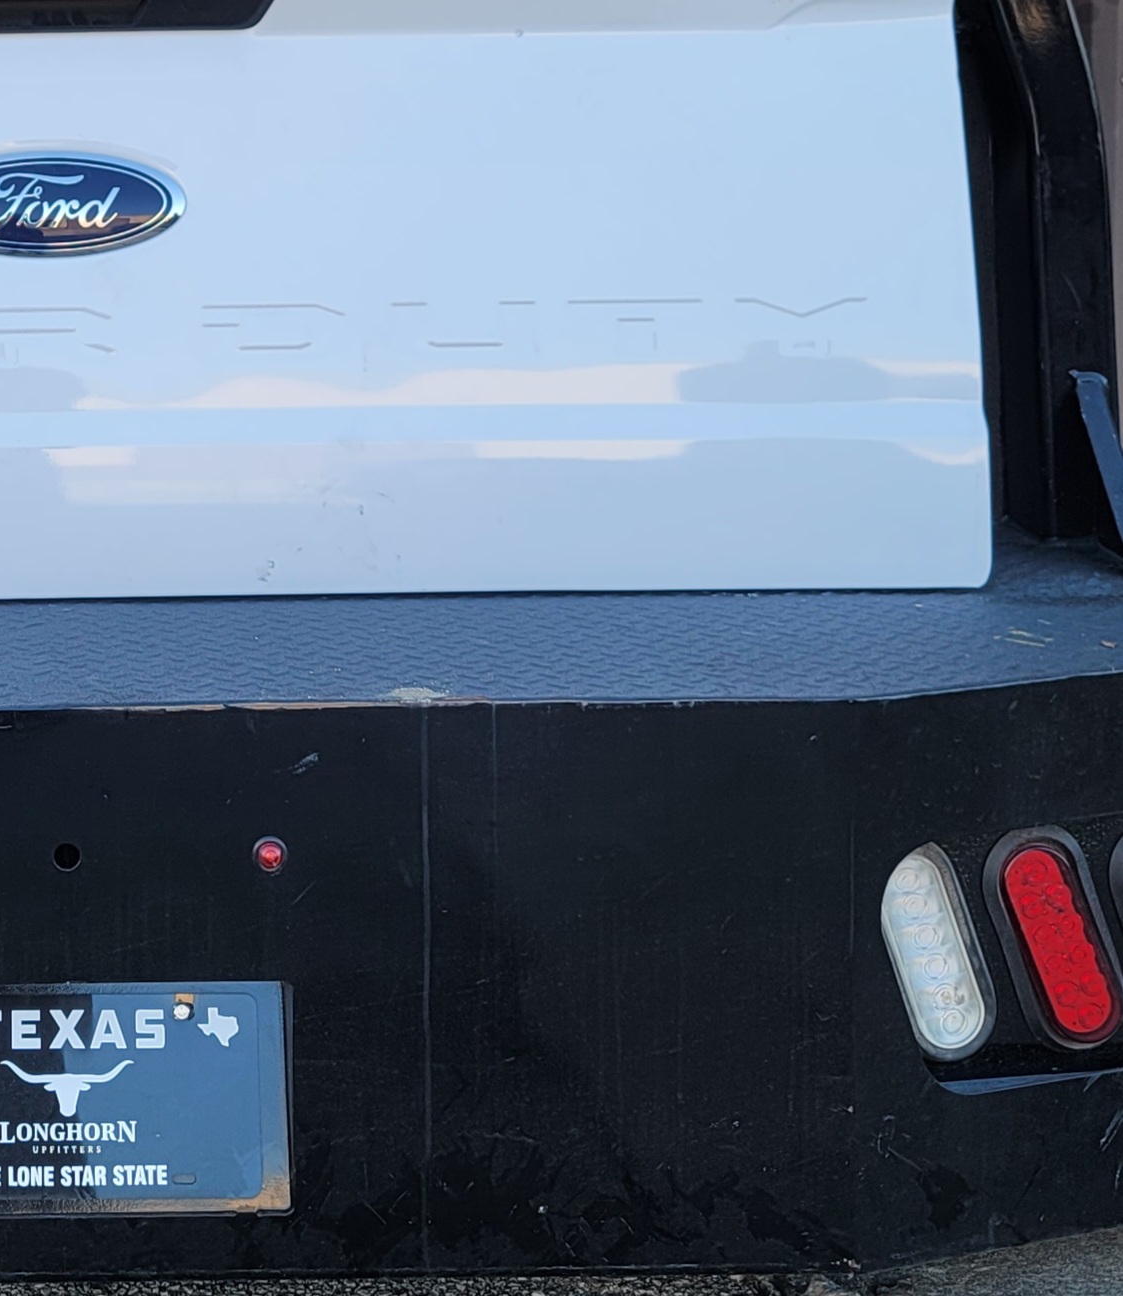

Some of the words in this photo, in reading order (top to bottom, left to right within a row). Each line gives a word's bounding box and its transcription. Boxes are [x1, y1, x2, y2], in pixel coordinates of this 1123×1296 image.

[201, 296, 869, 362] DUTY
[0, 1120, 138, 1144] LONGHORN
[32, 1145, 103, 1154] UPFITTERS
[8, 1165, 55, 1188] LONE
[60, 1165, 107, 1187] STAR
[112, 1164, 169, 1187] STATE
